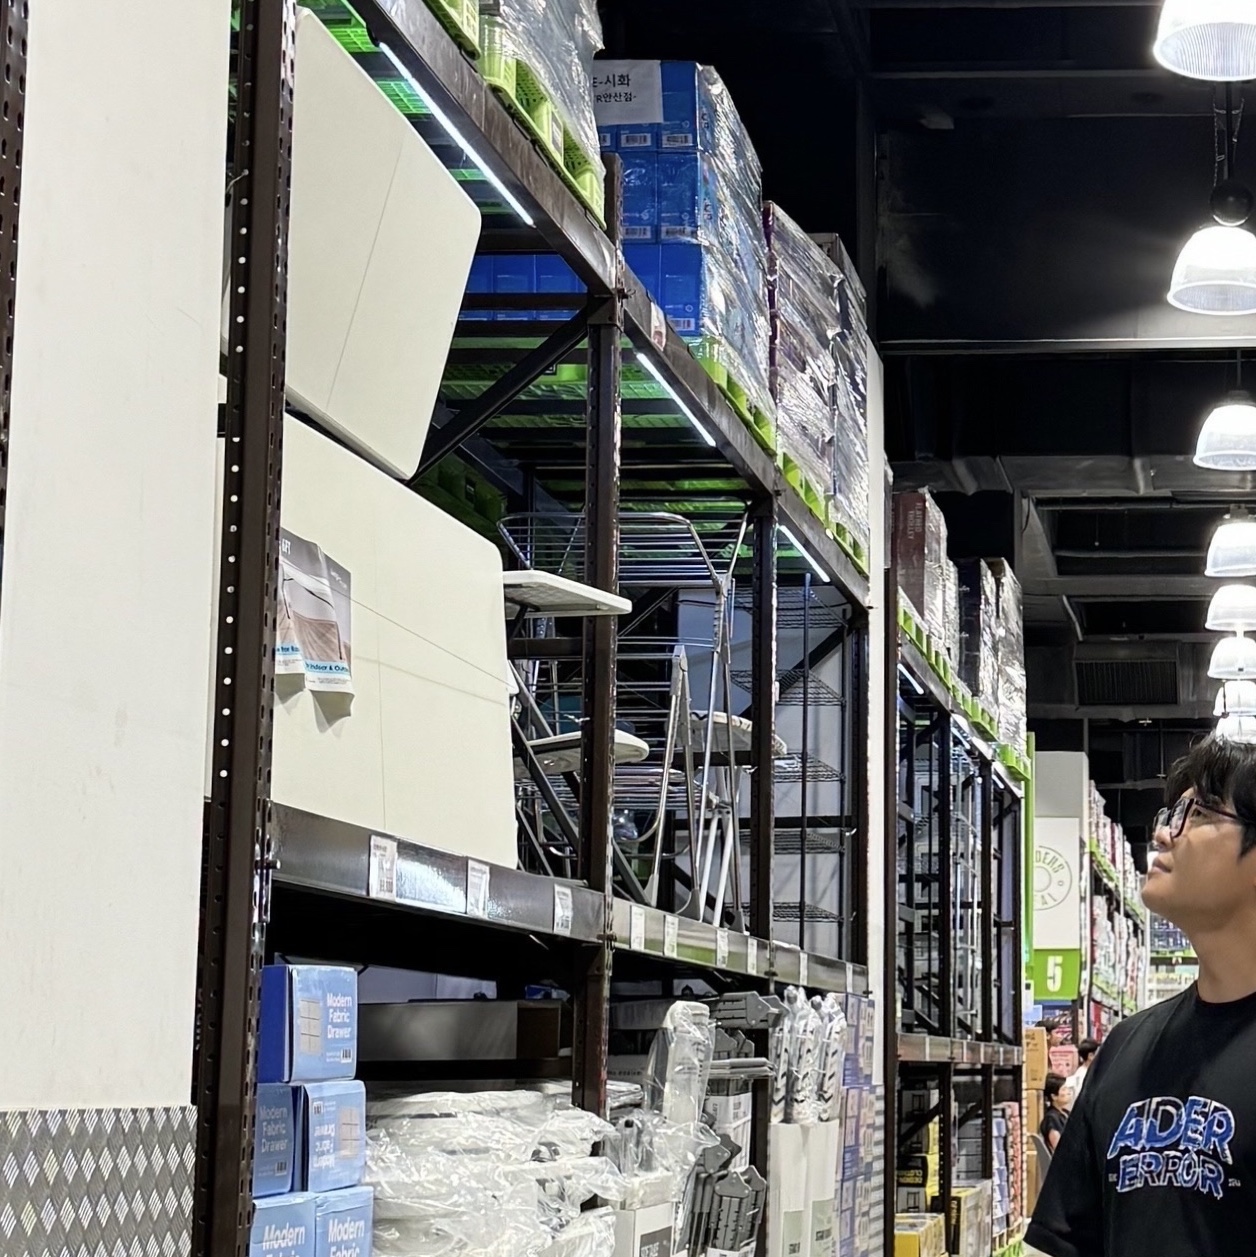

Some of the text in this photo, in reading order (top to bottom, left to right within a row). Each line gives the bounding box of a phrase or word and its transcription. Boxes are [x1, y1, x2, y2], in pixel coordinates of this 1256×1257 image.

[1046, 955, 1063, 992] 5
[326, 992, 352, 1008] Modern
[328, 1008, 350, 1023] Fabric
[327, 1025, 352, 1039] Drawer
[259, 1105, 288, 1121] Modern
[262, 1120, 286, 1136] Fabric
[1107, 1095, 1235, 1165] ADER
[261, 1138, 288, 1153] Drawer
[1116, 1151, 1224, 1200] ERROR
[263, 1222, 305, 1251] Modern
[328, 1217, 364, 1243] Modern
